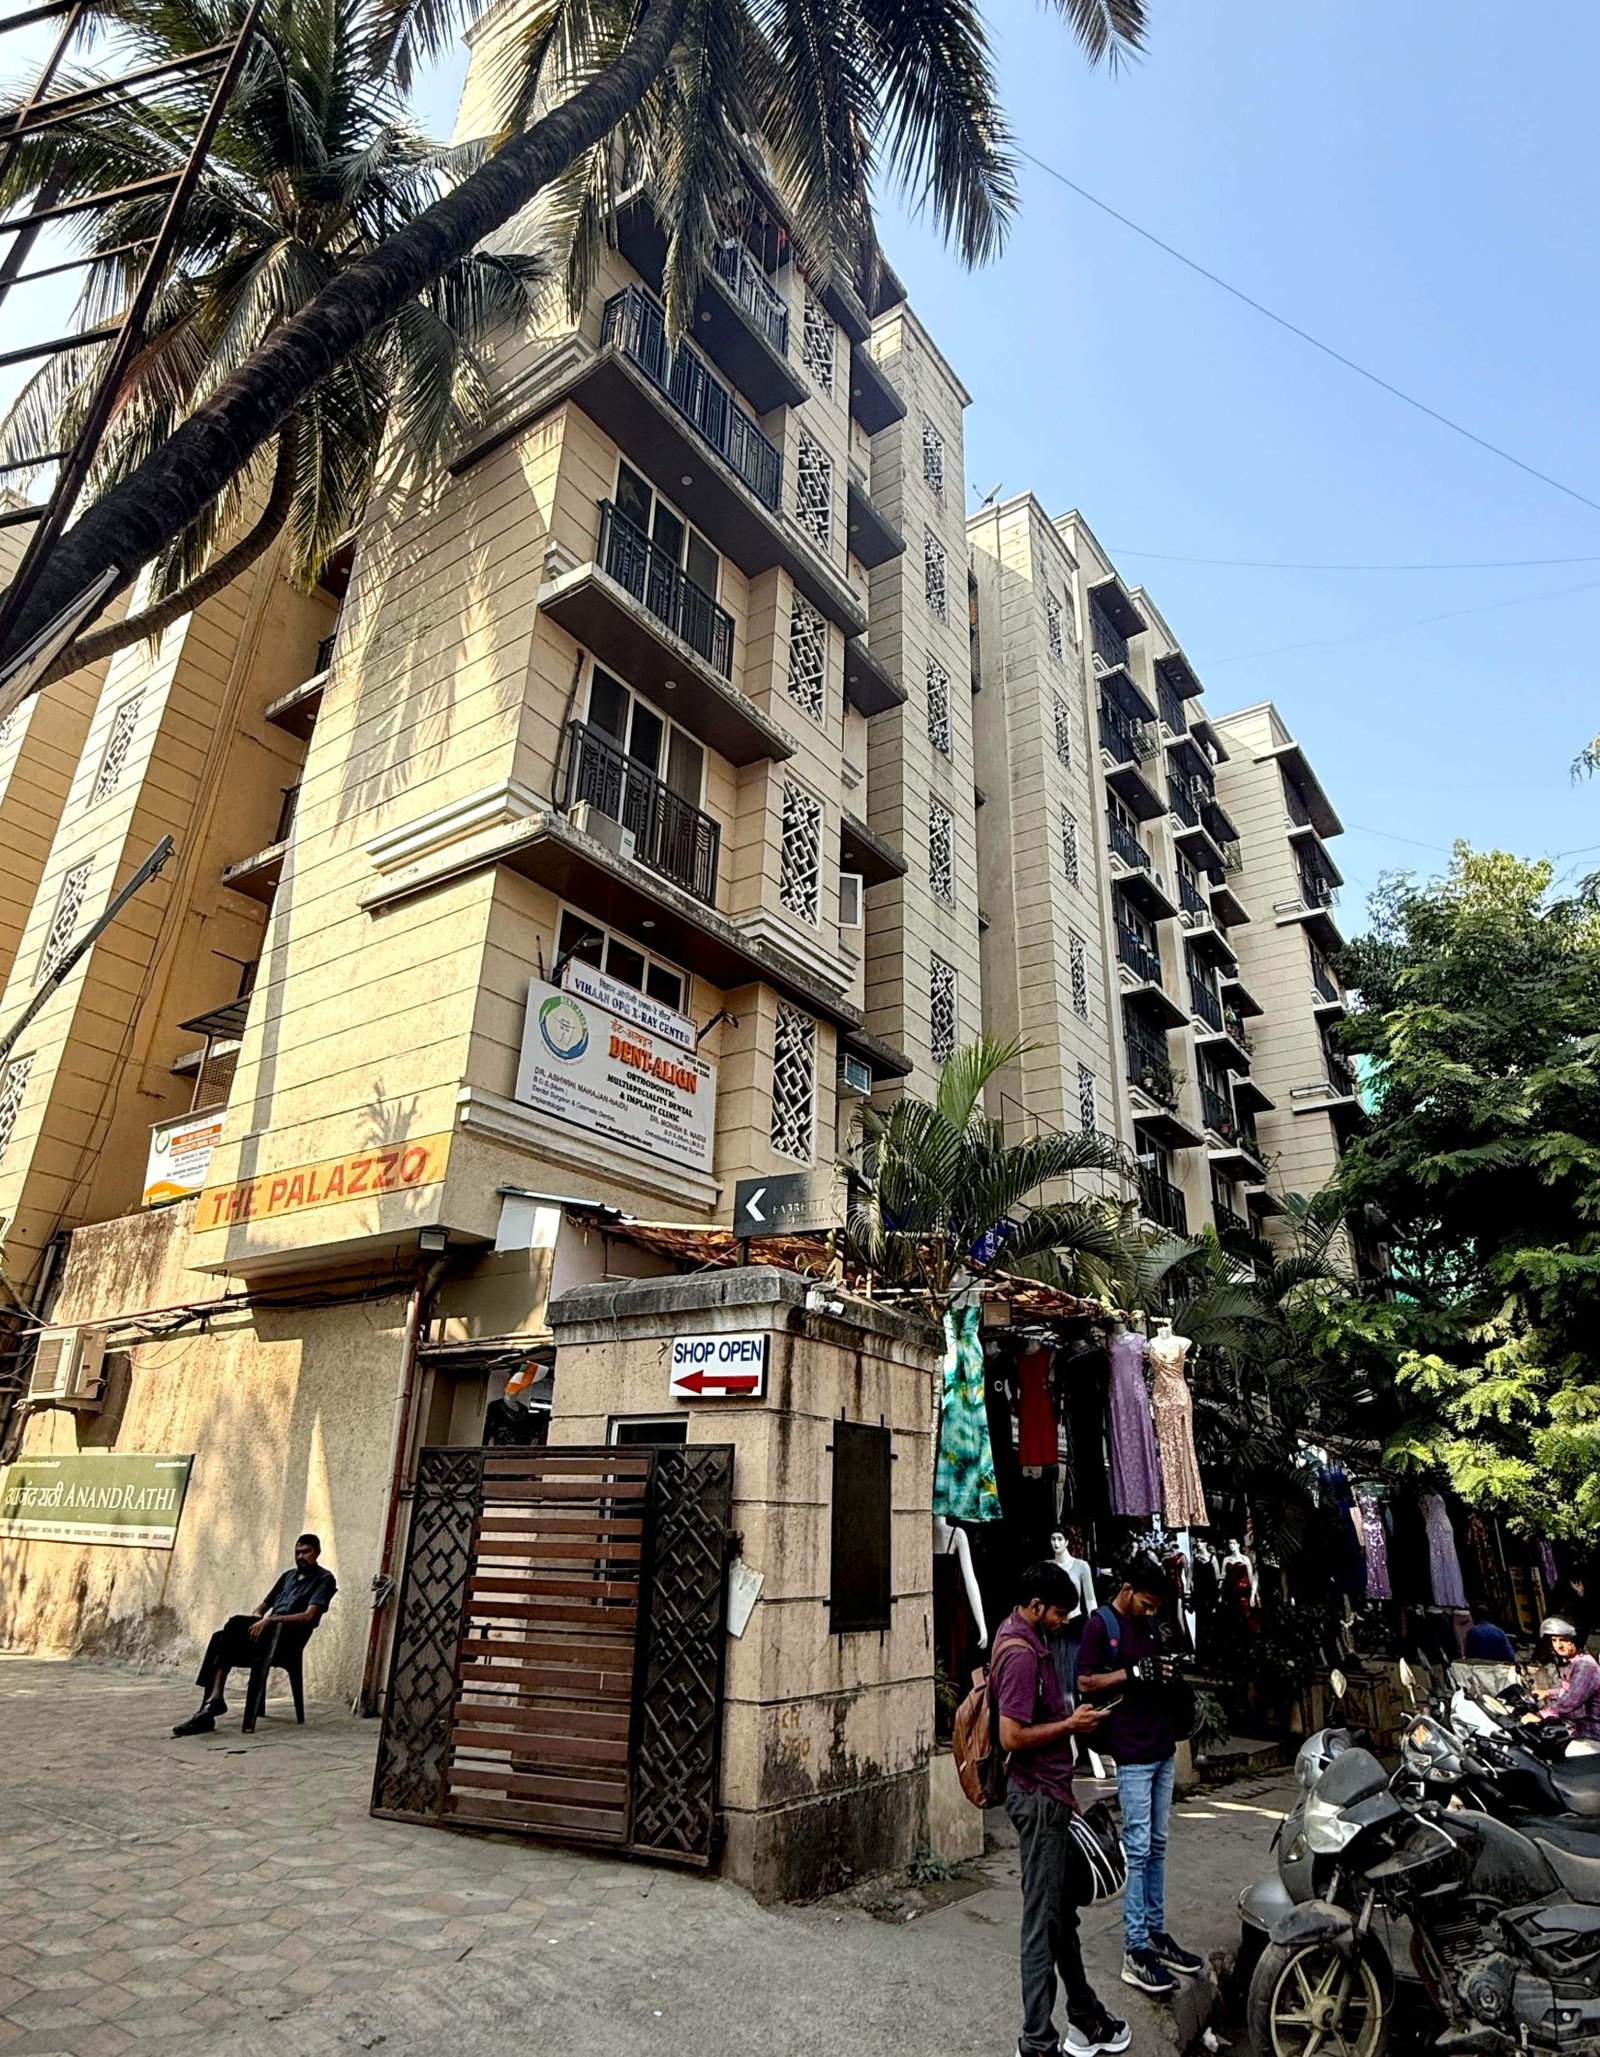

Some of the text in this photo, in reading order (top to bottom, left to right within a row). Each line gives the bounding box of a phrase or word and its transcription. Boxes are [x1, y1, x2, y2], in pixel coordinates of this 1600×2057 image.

[575, 978, 610, 1005] VIHAAN
[612, 998, 630, 1014] OPG
[632, 1008, 658, 1028] X-RAY
[659, 1021, 690, 1045] CENTER
[534, 1066, 546, 1077] DR.
[547, 1072, 577, 1089] ASHWINI
[609, 1035, 697, 1094] DENT-ALIGN
[607, 1074, 693, 1118] MULTISPECIALITY DENTAL
[620, 1092, 680, 1123] & IMPLANT CLINIC
[212, 1146, 427, 1225] THE PALAZZO
[674, 1339, 762, 1364] SHOP OPEN
